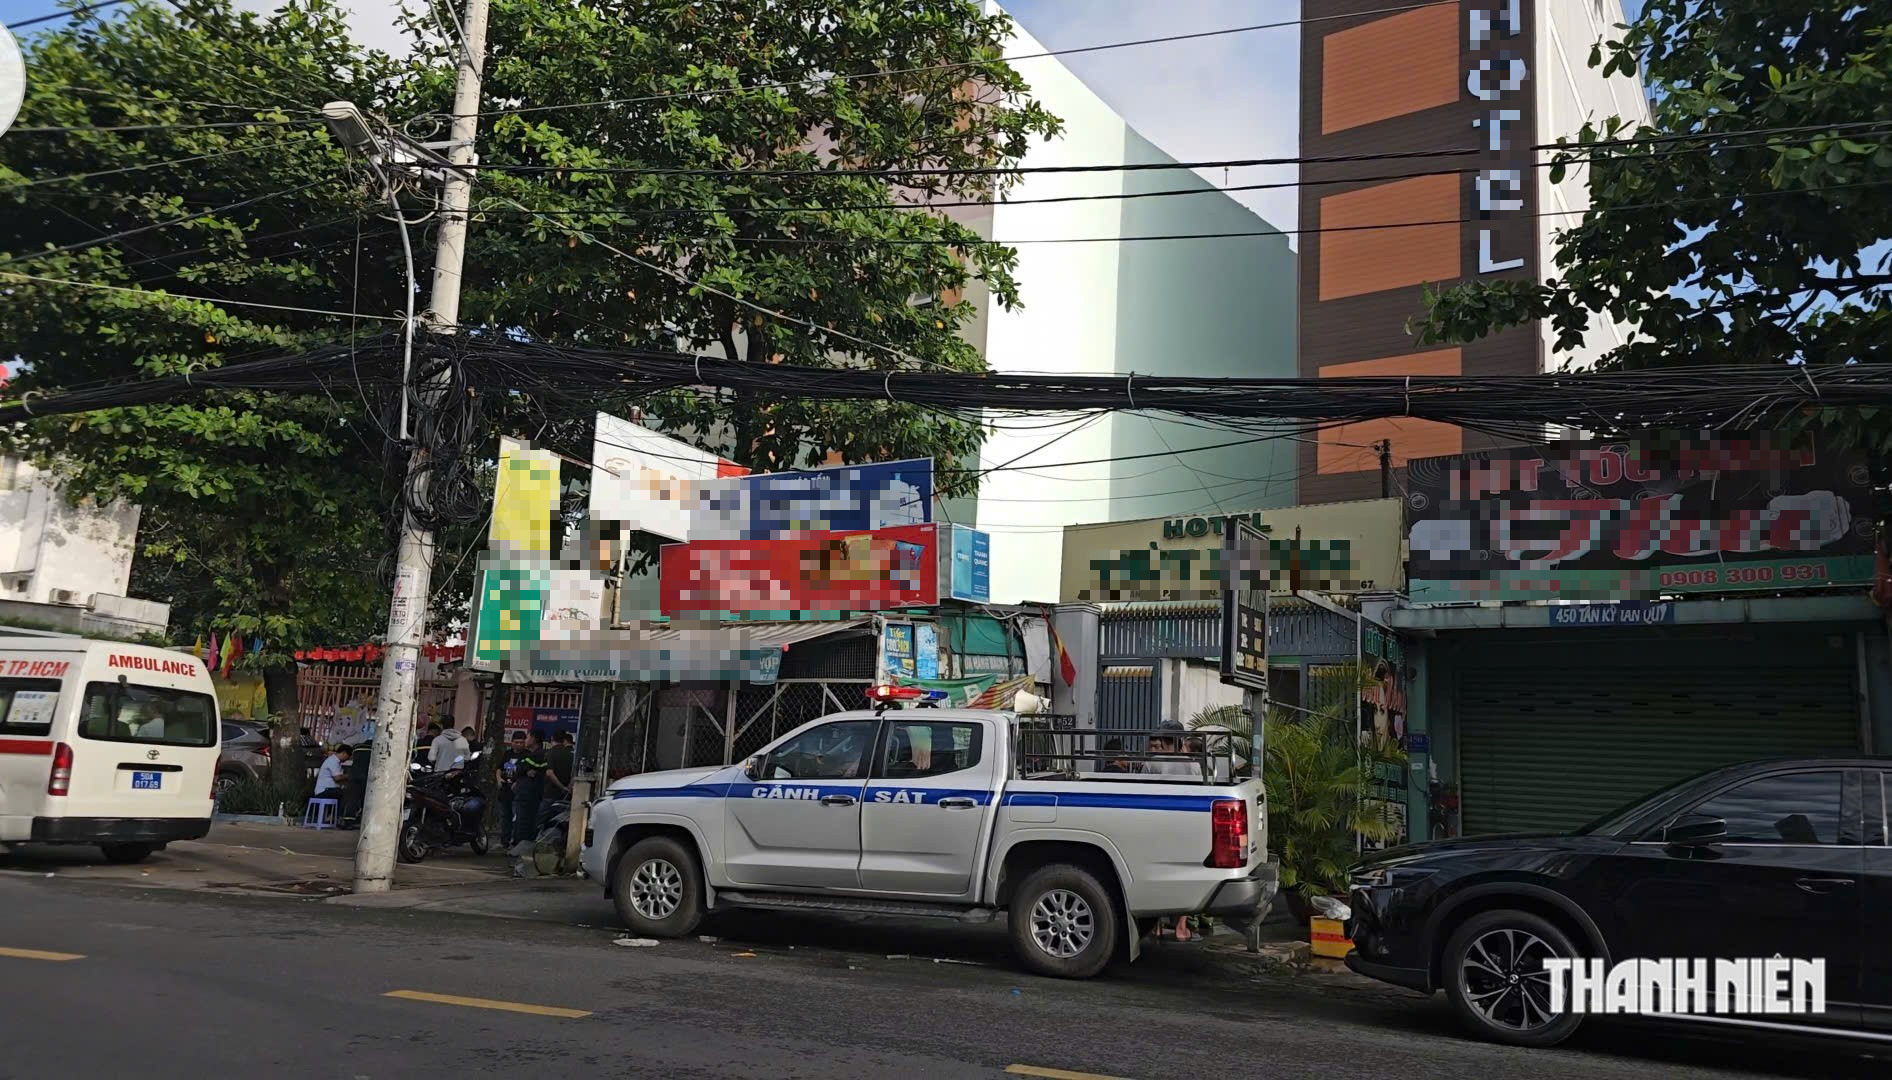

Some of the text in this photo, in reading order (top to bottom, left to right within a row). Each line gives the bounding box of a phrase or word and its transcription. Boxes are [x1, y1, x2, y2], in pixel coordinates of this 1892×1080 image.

[1660, 571, 1718, 588] 0908
[1726, 567, 1773, 583] 300
[1780, 564, 1828, 580] 931
[1555, 608, 1577, 623] 450
[7, 660, 70, 677] TP.HCM
[108, 654, 196, 677] AMBULANCE
[752, 785, 820, 801] CẢNH
[874, 789, 927, 804] SÁT
